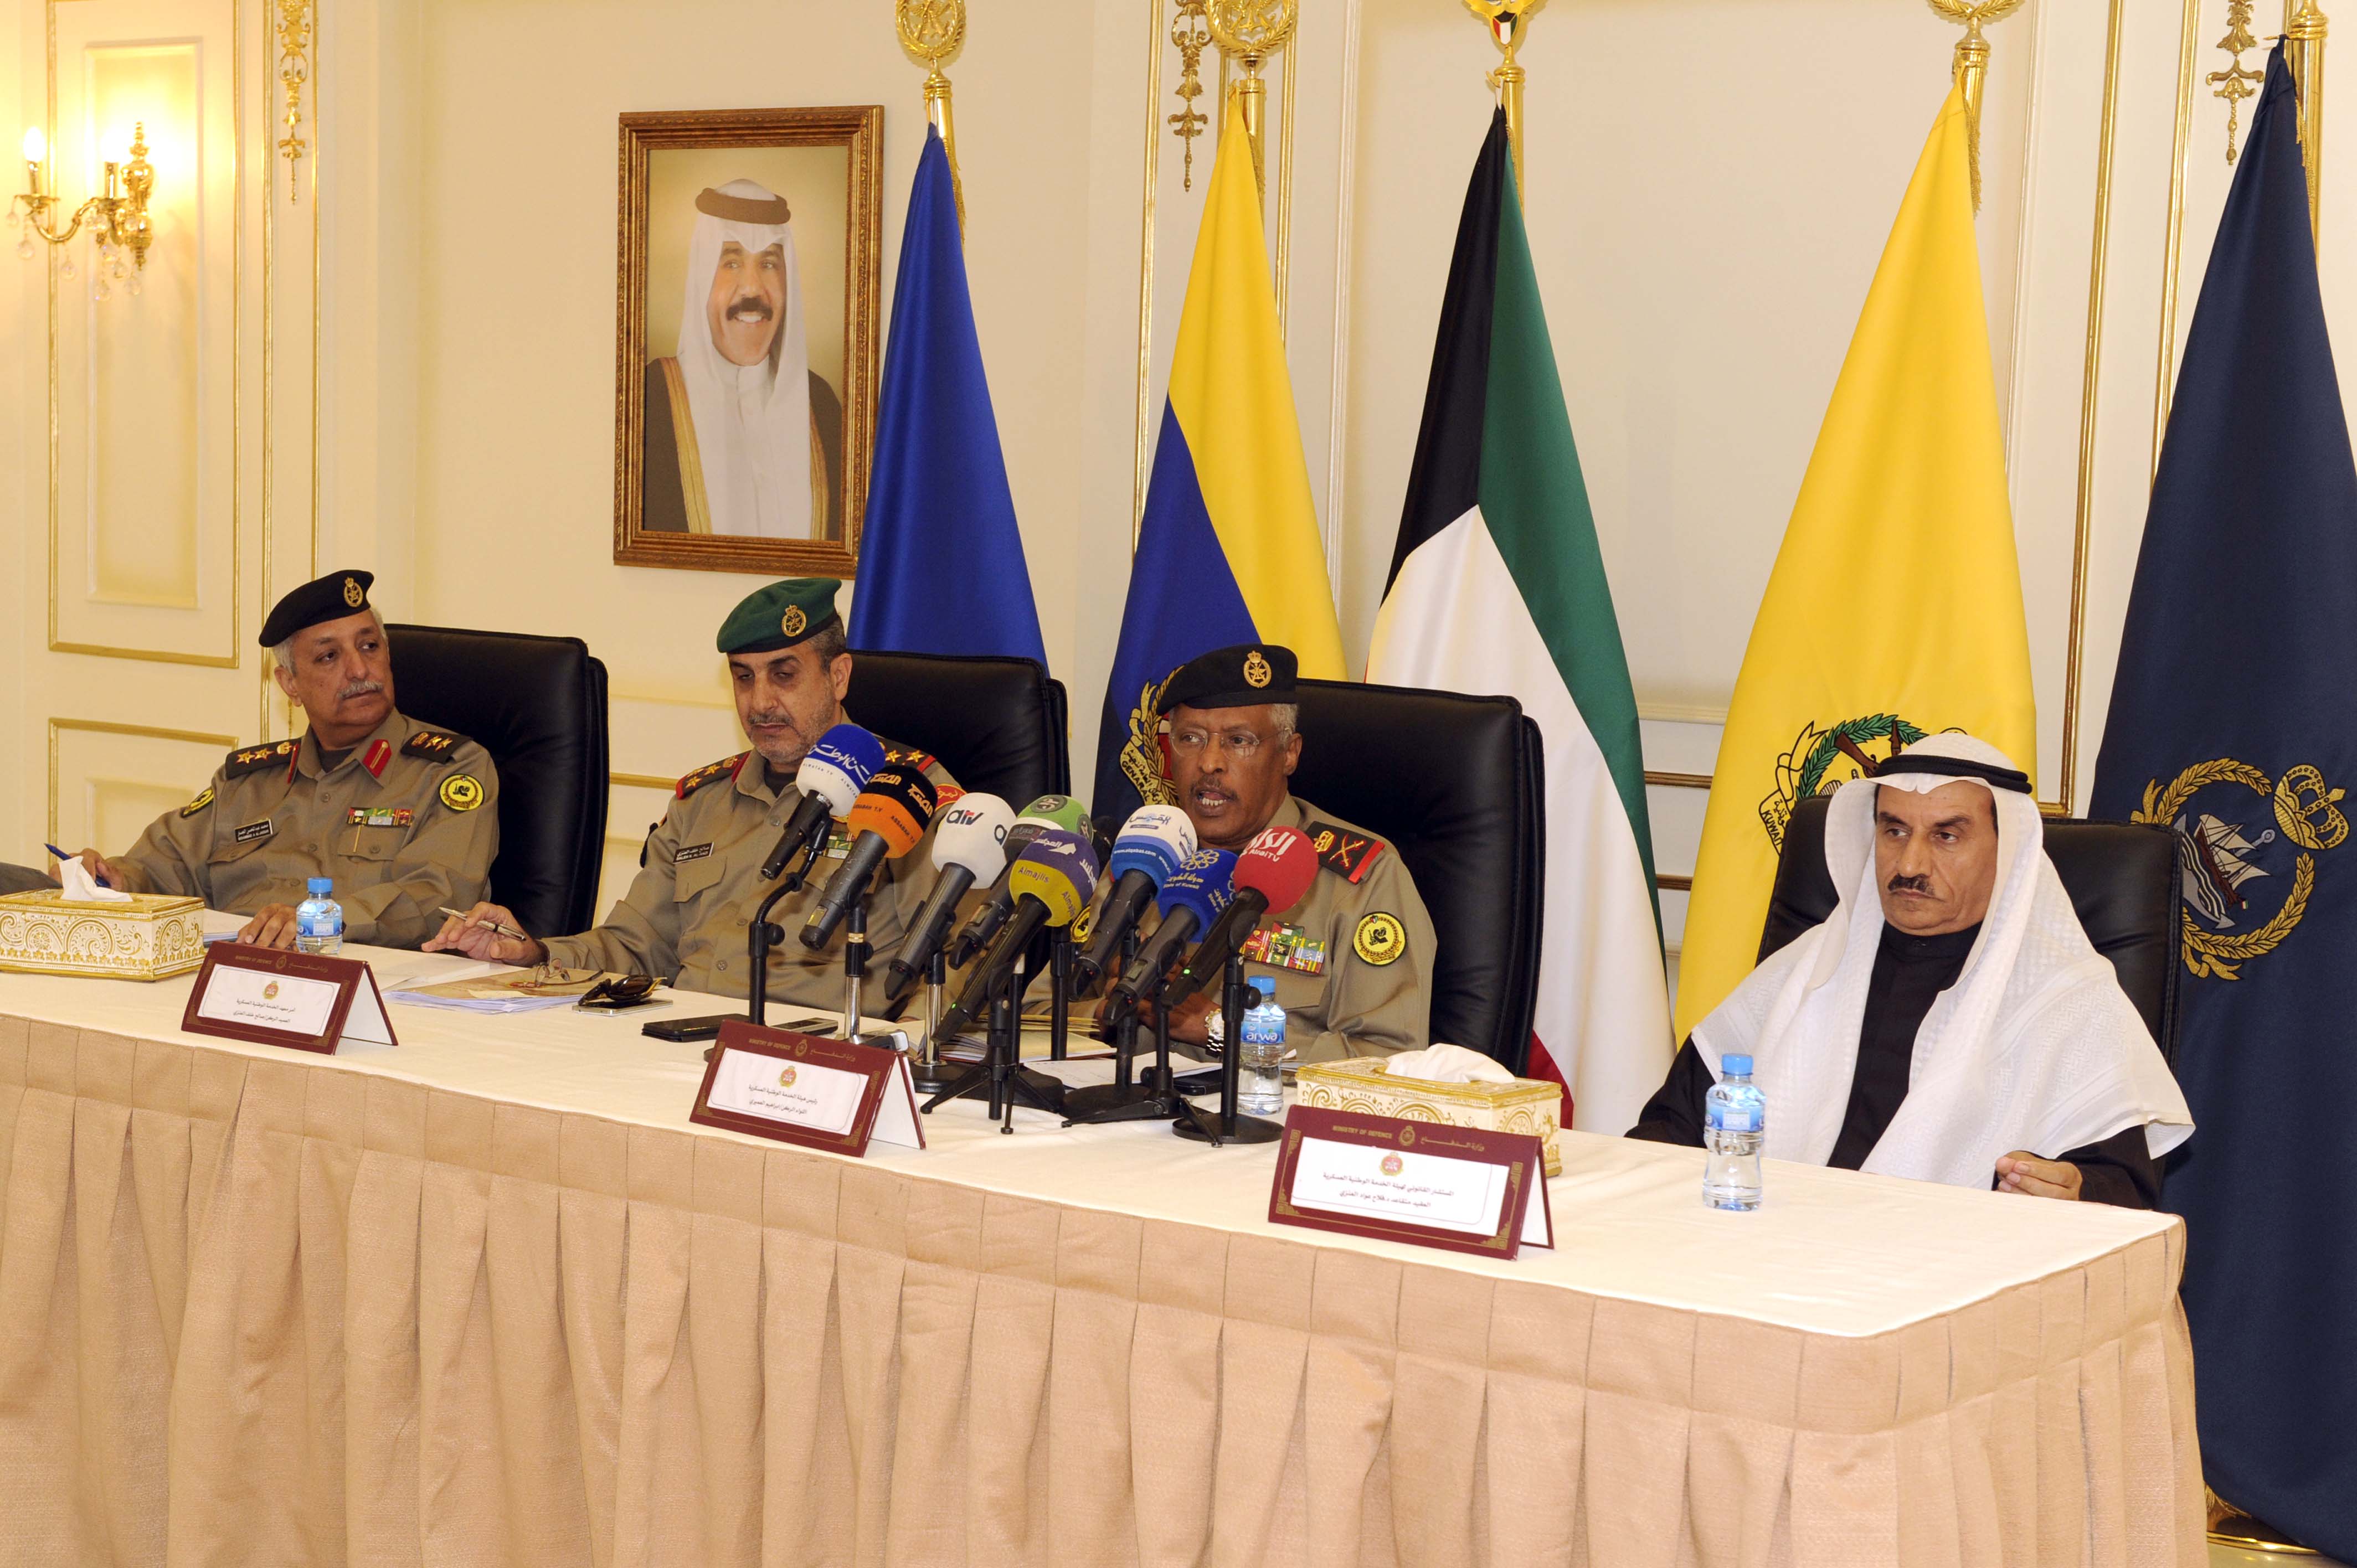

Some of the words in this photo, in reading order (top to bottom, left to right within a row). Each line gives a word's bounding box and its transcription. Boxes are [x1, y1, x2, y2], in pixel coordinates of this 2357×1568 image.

[1121, 760, 1150, 801] GENARAL
[1018, 866, 1050, 884] Almajlis
[1246, 1031, 1278, 1043] arwa
[749, 1084, 766, 1092] العسكرية
[766, 1087, 782, 1096] الوطنية
[1332, 1125, 1358, 1134] MINISTRY
[1368, 1129, 1393, 1139] DEFENCE
[1323, 1172, 1347, 1180] العسكرية
[1349, 1175, 1370, 1185] الوطنية
[1372, 1178, 1391, 1187] الخدمة
